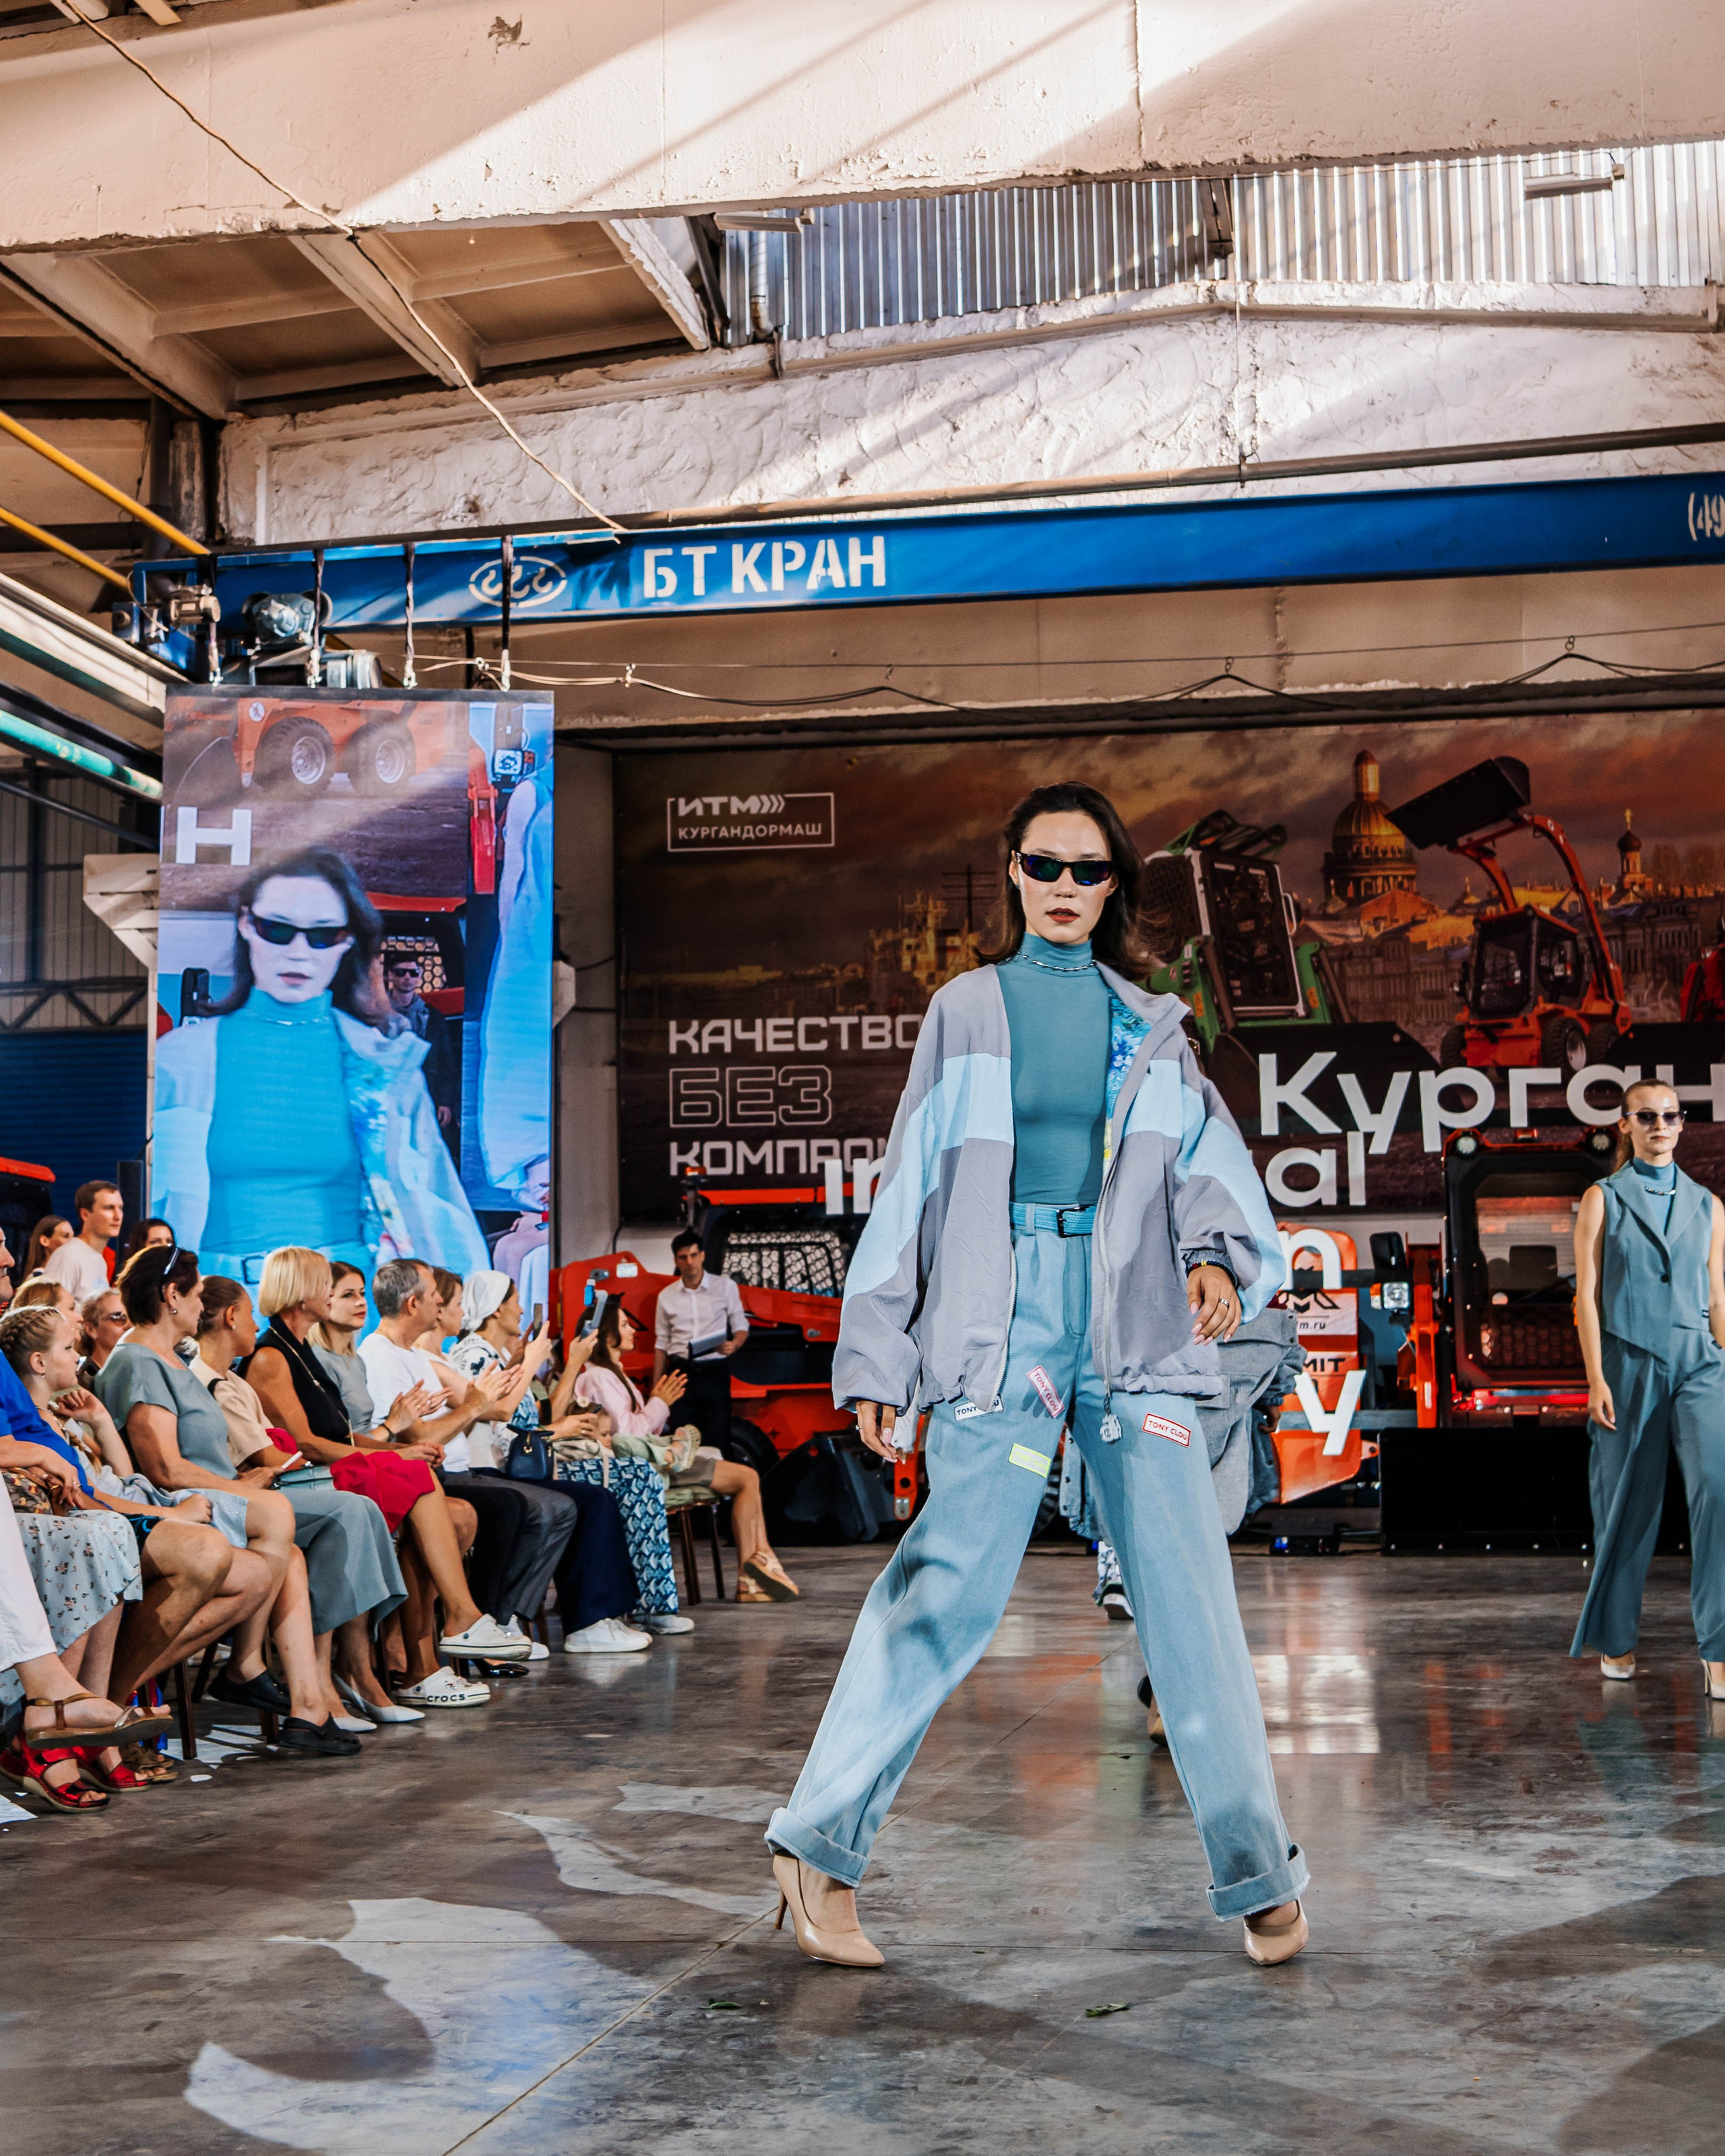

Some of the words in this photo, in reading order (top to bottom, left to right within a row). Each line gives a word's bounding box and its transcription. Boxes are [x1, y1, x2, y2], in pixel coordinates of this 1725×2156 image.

[644, 545, 717, 598] БТ
[732, 536, 886, 594] КРАН
[678, 795, 762, 817] ИТМ
[679, 822, 822, 840] КУРГАНДОРМАШ
[669, 1014, 924, 1054] КАЧЕСТВО
[669, 1065, 832, 1128] БЕЗ
[670, 1137, 887, 1176] КОМПРО
[1249, 1131, 1367, 1208] al
[956, 1405, 977, 1416] TONY
[1034, 1372, 1049, 1392] TONY
[1046, 1393, 1059, 1411] CLOU
[1149, 1420, 1169, 1432] TONY
[1170, 1428, 1188, 1440] CLOU
[427, 1693, 466, 1703] crocs
